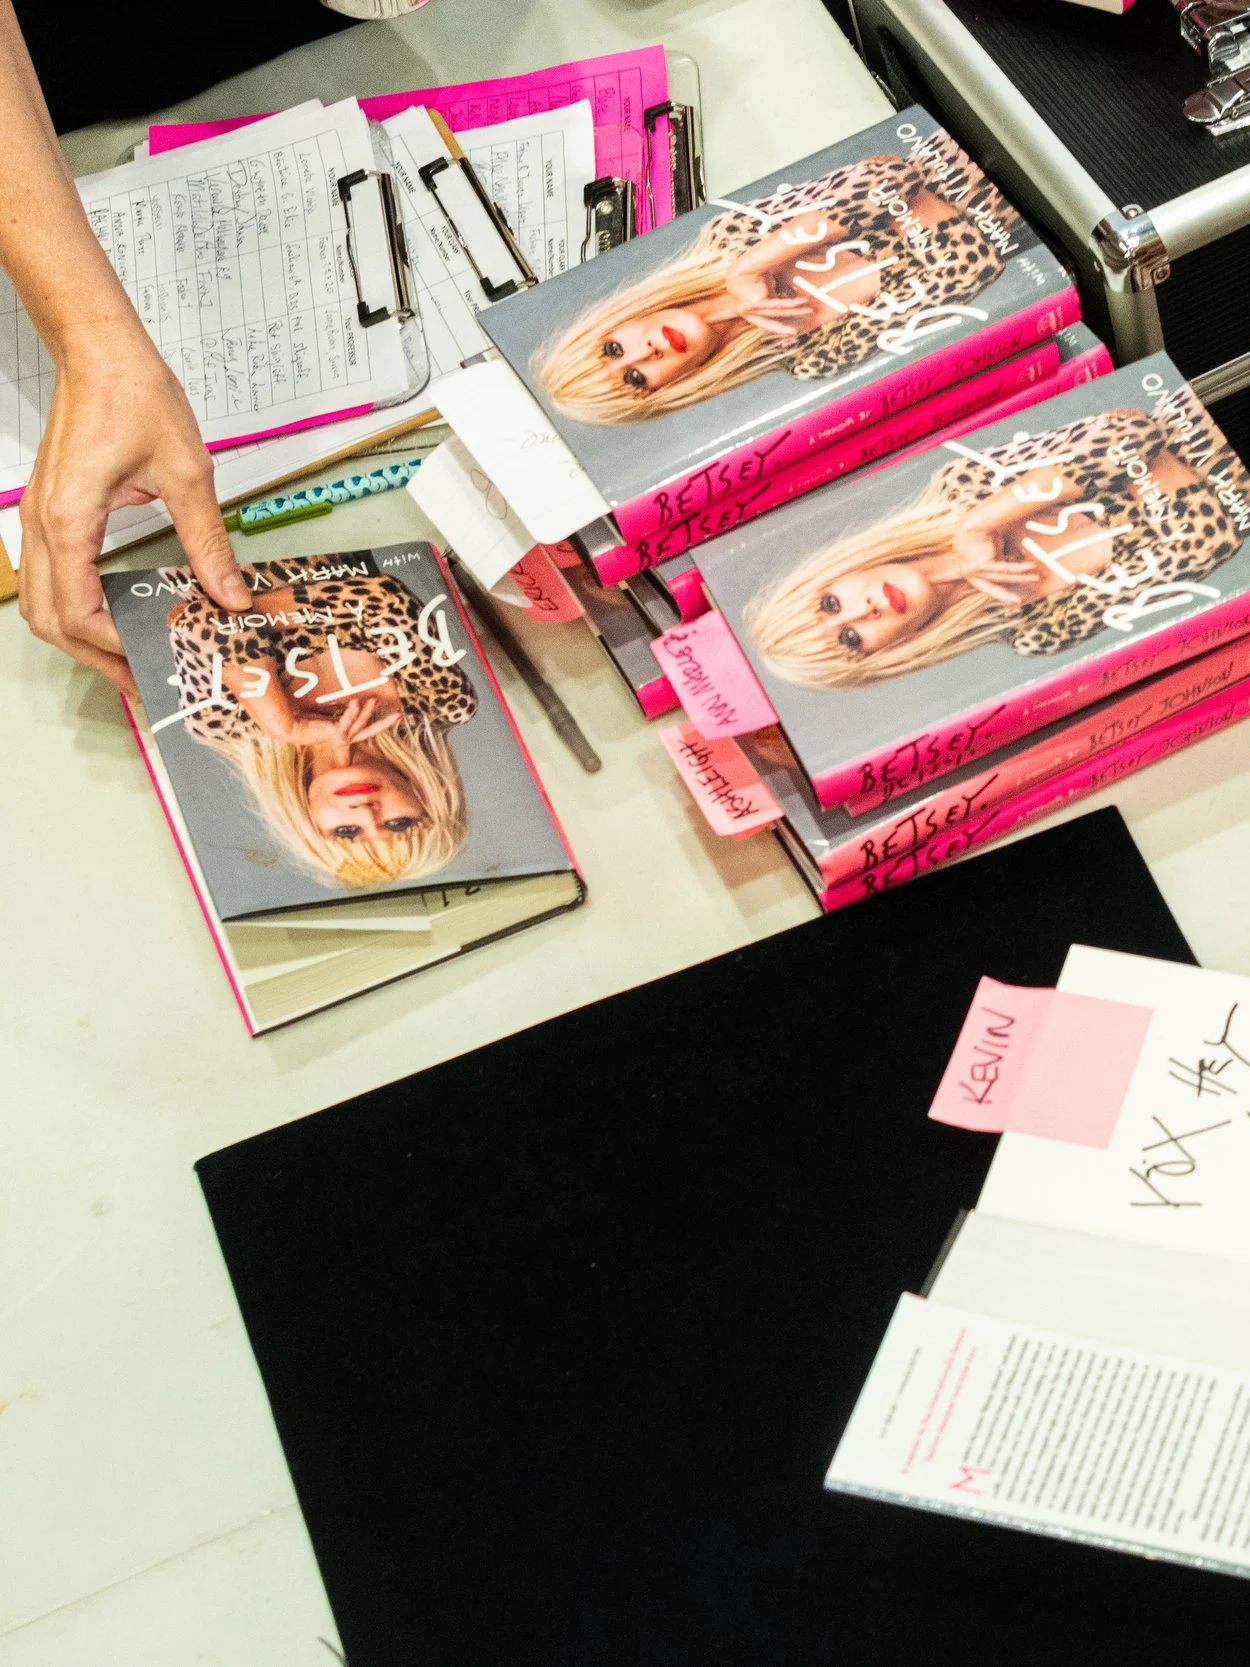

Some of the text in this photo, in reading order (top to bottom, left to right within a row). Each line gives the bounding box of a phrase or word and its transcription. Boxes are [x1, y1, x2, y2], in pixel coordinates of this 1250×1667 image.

[622, 97, 632, 114] YOUR
[326, 167, 339, 207] YOUR NAME
[401, 177, 415, 194] NAME
[544, 159, 553, 198] YOUR NAME
[440, 225, 460, 255] YOUR CLASS
[966, 199, 1018, 255] MARK
[707, 184, 989, 356] BETSEY.
[462, 289, 475, 304] Your
[343, 317, 357, 365] Your PROFESSOR
[655, 430, 792, 527] BETSEY.
[940, 430, 1222, 633] BETSEY.
[293, 562, 368, 584] MARK
[151, 594, 468, 733] BETSEY.
[674, 739, 758, 820] ASHLEIGH
[861, 774, 999, 871] BETSEY.
[958, 1005, 1016, 1105] KEVIN
